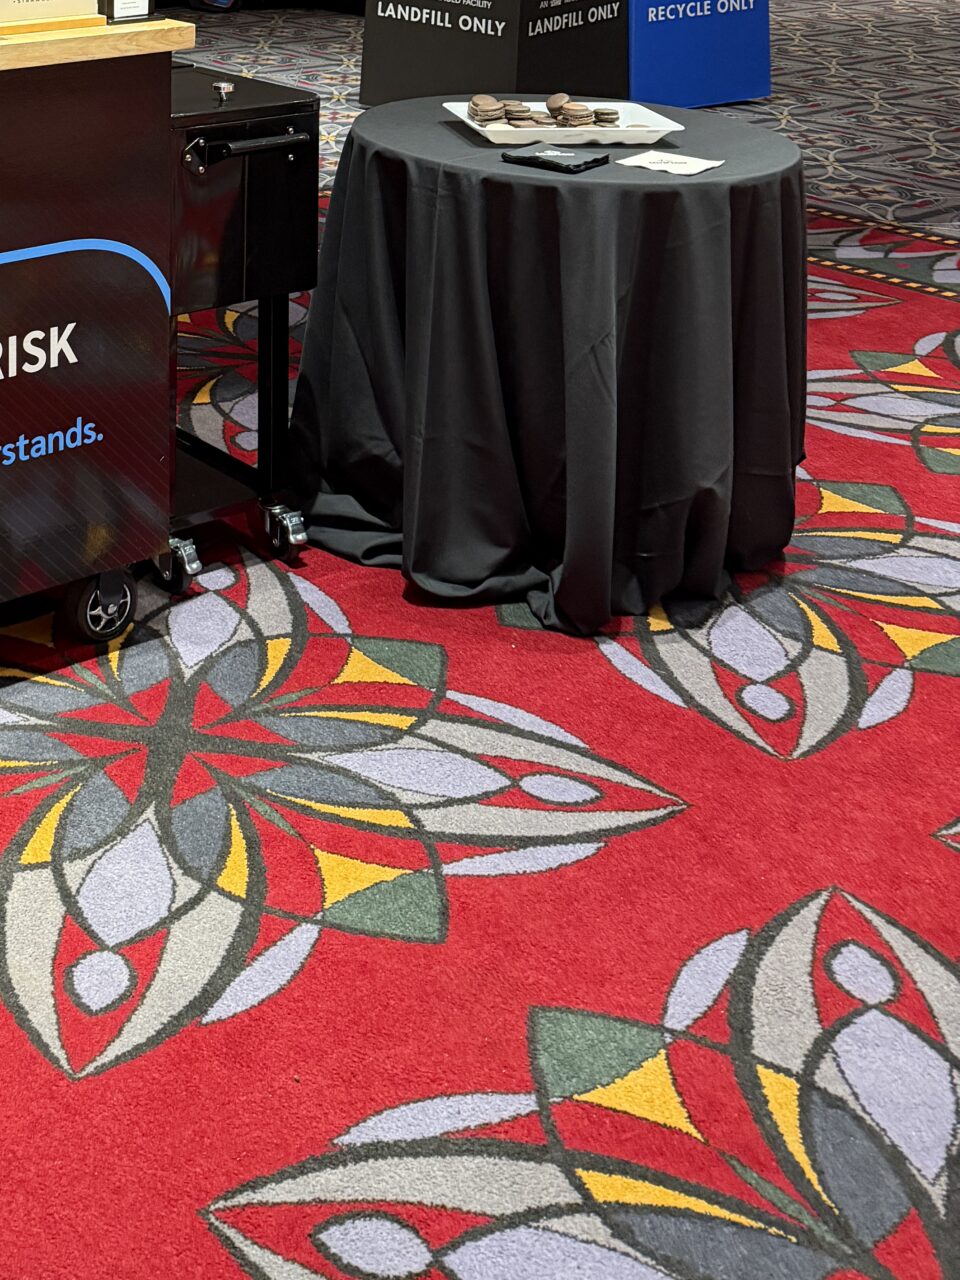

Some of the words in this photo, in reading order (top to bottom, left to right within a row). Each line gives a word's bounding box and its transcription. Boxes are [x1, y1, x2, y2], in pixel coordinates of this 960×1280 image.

[377, 0, 452, 28] LANDFILL
[458, 14, 506, 37] ONLY
[528, 10, 584, 37] LANDFILL
[587, 1, 620, 23] ONLY
[539, 0, 549, 9] AN
[647, 0, 711, 23] RECYCLE
